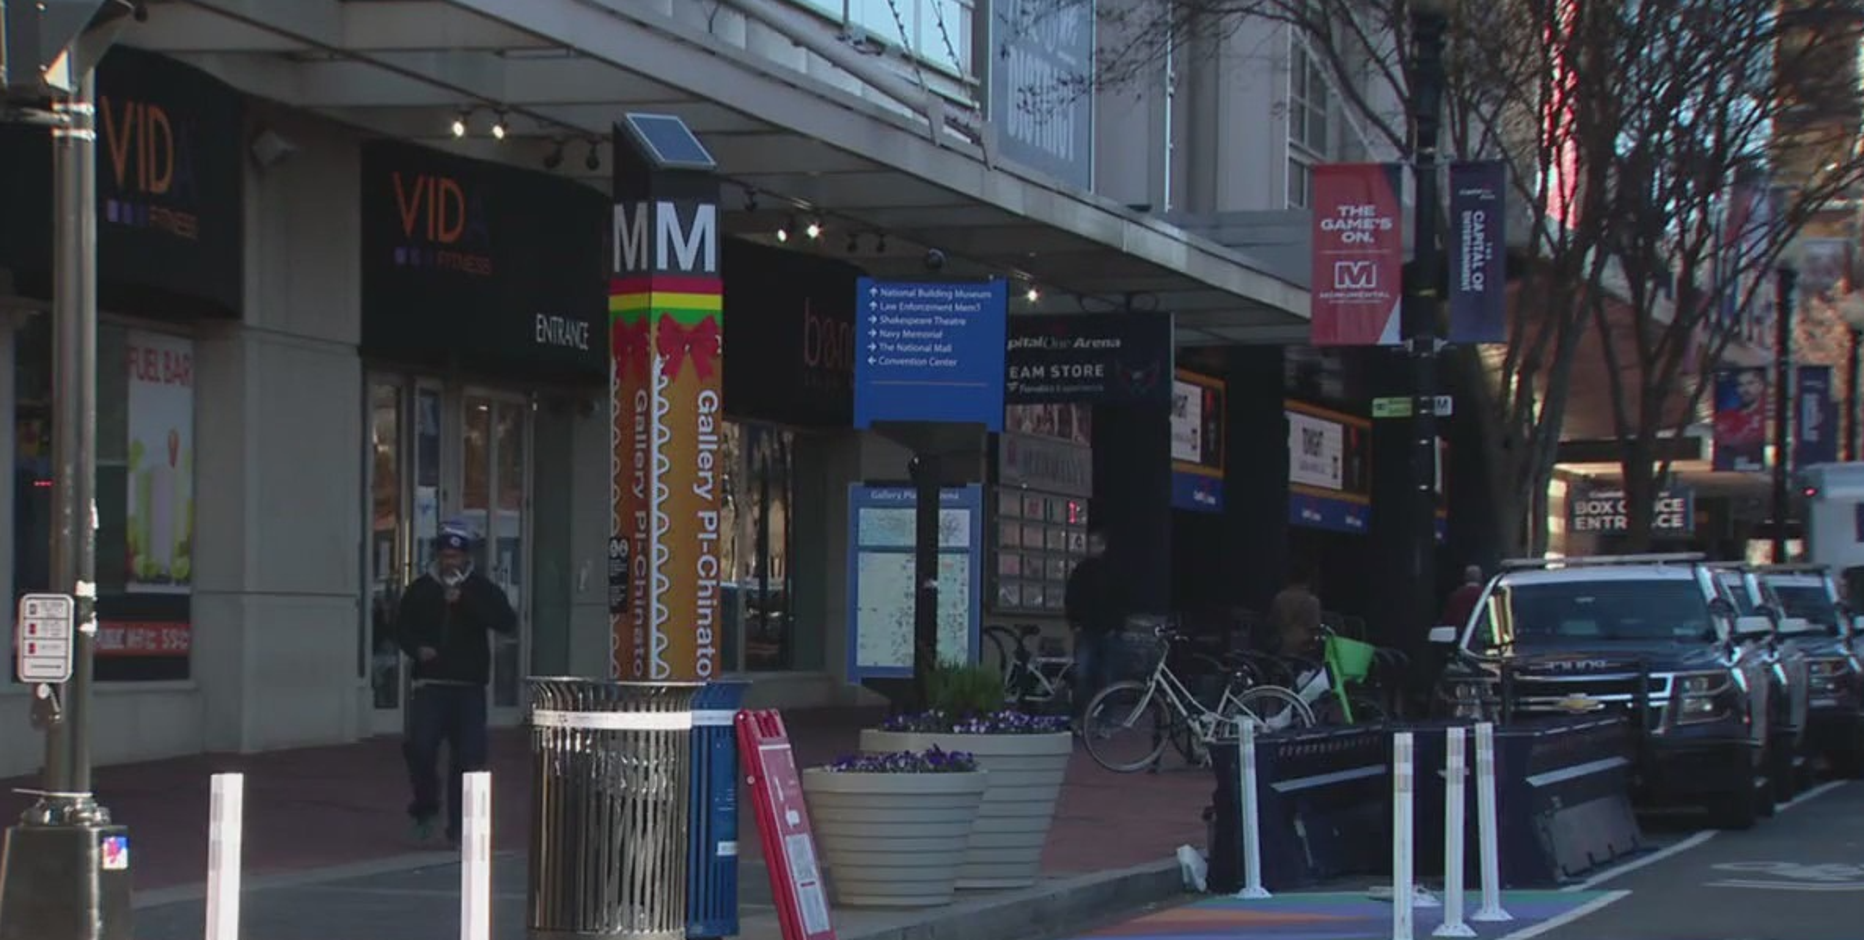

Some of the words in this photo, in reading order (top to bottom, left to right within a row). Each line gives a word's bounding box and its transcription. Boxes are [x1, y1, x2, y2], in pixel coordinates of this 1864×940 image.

[1337, 205, 1375, 216] THE
[1321, 218, 1393, 230] GAME'S
[614, 203, 649, 272] M
[657, 202, 716, 272] M
[1341, 232, 1375, 243] ON.
[1472, 210, 1485, 269] CAPITAL
[437, 250, 492, 275] FITNESS
[1471, 271, 1485, 291] OF
[880, 288, 914, 297] National
[917, 288, 953, 300] Building
[955, 289, 992, 298] Museum
[880, 302, 897, 310] Law
[899, 302, 952, 311] Enforcement
[880, 316, 932, 326] Shakespeare
[934, 317, 966, 325] Theatre
[536, 313, 589, 350] ENTRANCE
[880, 330, 900, 340] Navy
[902, 330, 943, 338] Memorial
[880, 343, 894, 351] The
[897, 343, 932, 352] National
[934, 344, 952, 352] Mall
[1073, 337, 1122, 348] Arena
[126, 347, 160, 381] FUEL
[164, 350, 192, 386] BAR
[879, 356, 927, 365] Convention
[929, 357, 957, 366] Center
[1009, 365, 1045, 379] EAM
[1050, 364, 1105, 378] STORE
[633, 389, 648, 499] Gallery
[693, 389, 719, 500] Gallery
[870, 489, 902, 500] Gallery
[1575, 501, 1613, 514] BOX
[1575, 514, 1684, 530] ENTRCE
[633, 511, 648, 677] Pl-Chinato
[694, 511, 719, 677] Pl-Chinato
